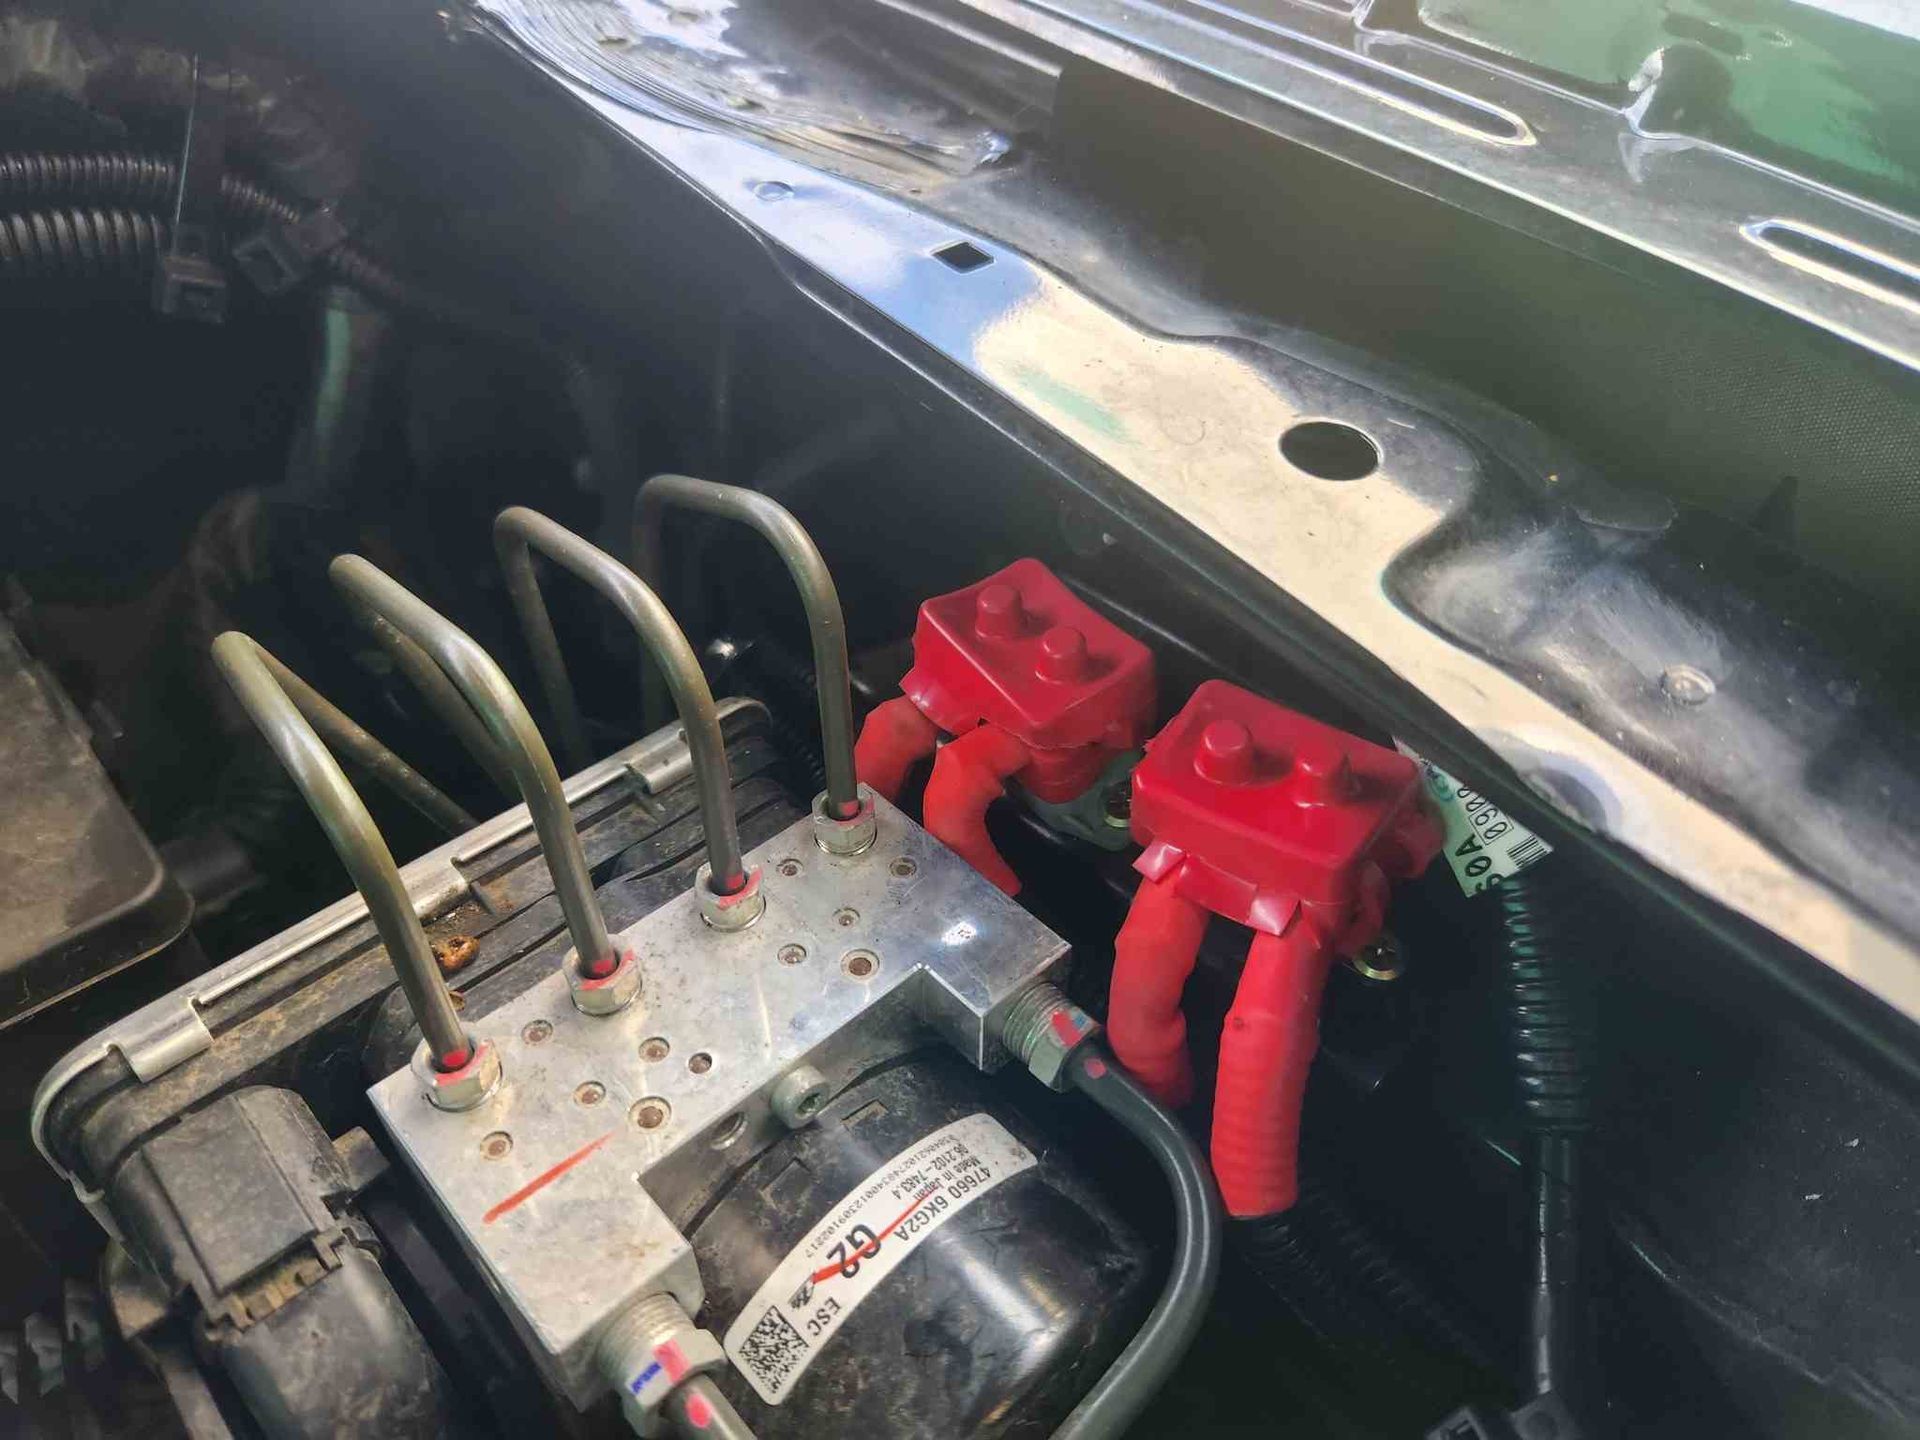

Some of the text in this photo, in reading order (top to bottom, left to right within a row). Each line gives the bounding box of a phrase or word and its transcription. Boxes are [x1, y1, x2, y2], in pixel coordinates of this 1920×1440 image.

[913, 1155, 981, 1201] Made in Japan
[894, 1166, 991, 1242] 47660 6KG2A
[826, 1224, 881, 1279] G2
[806, 1297, 841, 1336] ESC
